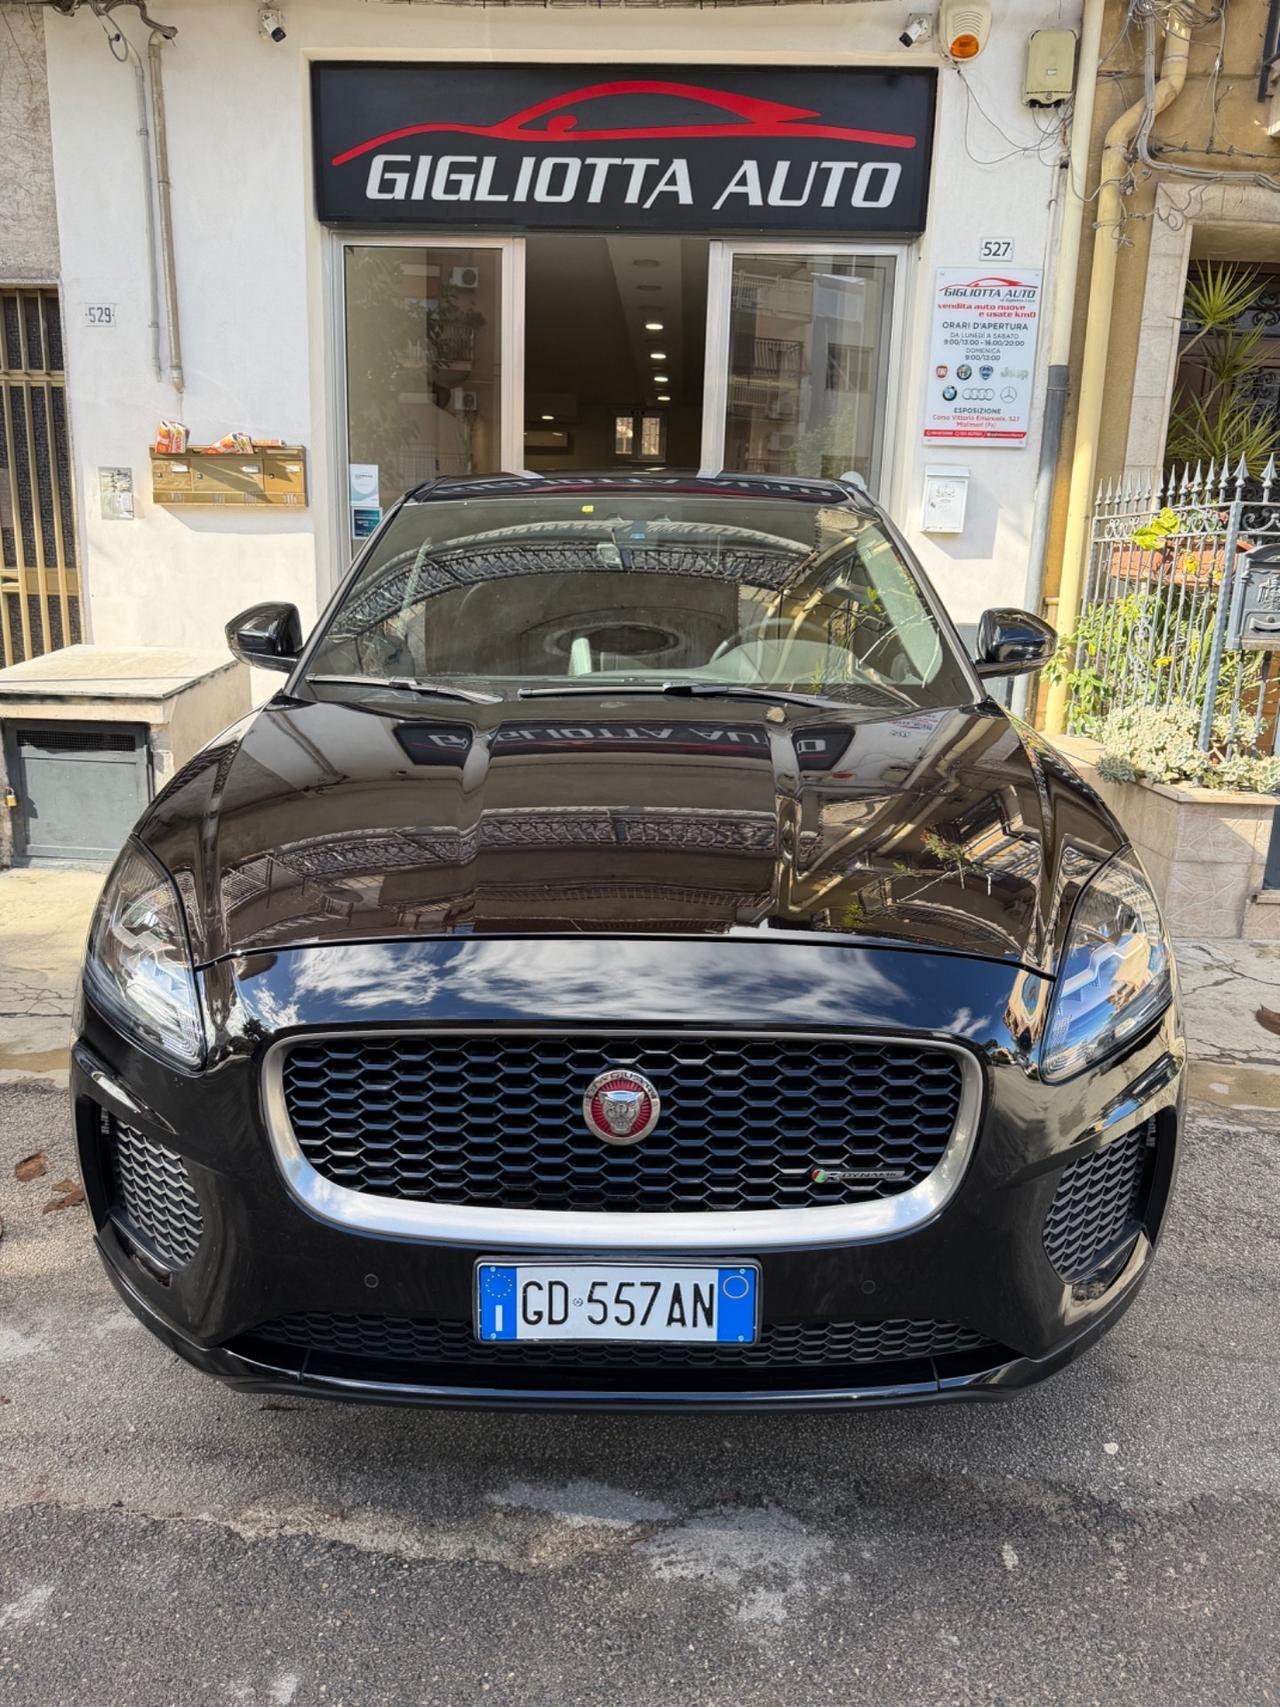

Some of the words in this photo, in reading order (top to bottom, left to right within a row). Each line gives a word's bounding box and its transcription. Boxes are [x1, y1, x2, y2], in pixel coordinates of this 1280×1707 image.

[365, 153, 694, 208] GIGLIOTTA
[712, 159, 903, 210] AUTO
[983, 241, 1011, 257] 527
[944, 287, 1001, 298] GIGLIOTTA
[1004, 288, 1036, 299] AUTO
[88, 306, 112, 323] 529
[942, 321, 970, 329] ORARI
[973, 322, 1028, 330] D'APERTURA
[521, 1280, 569, 1326] GD
[586, 1281, 715, 1328] 557AN
